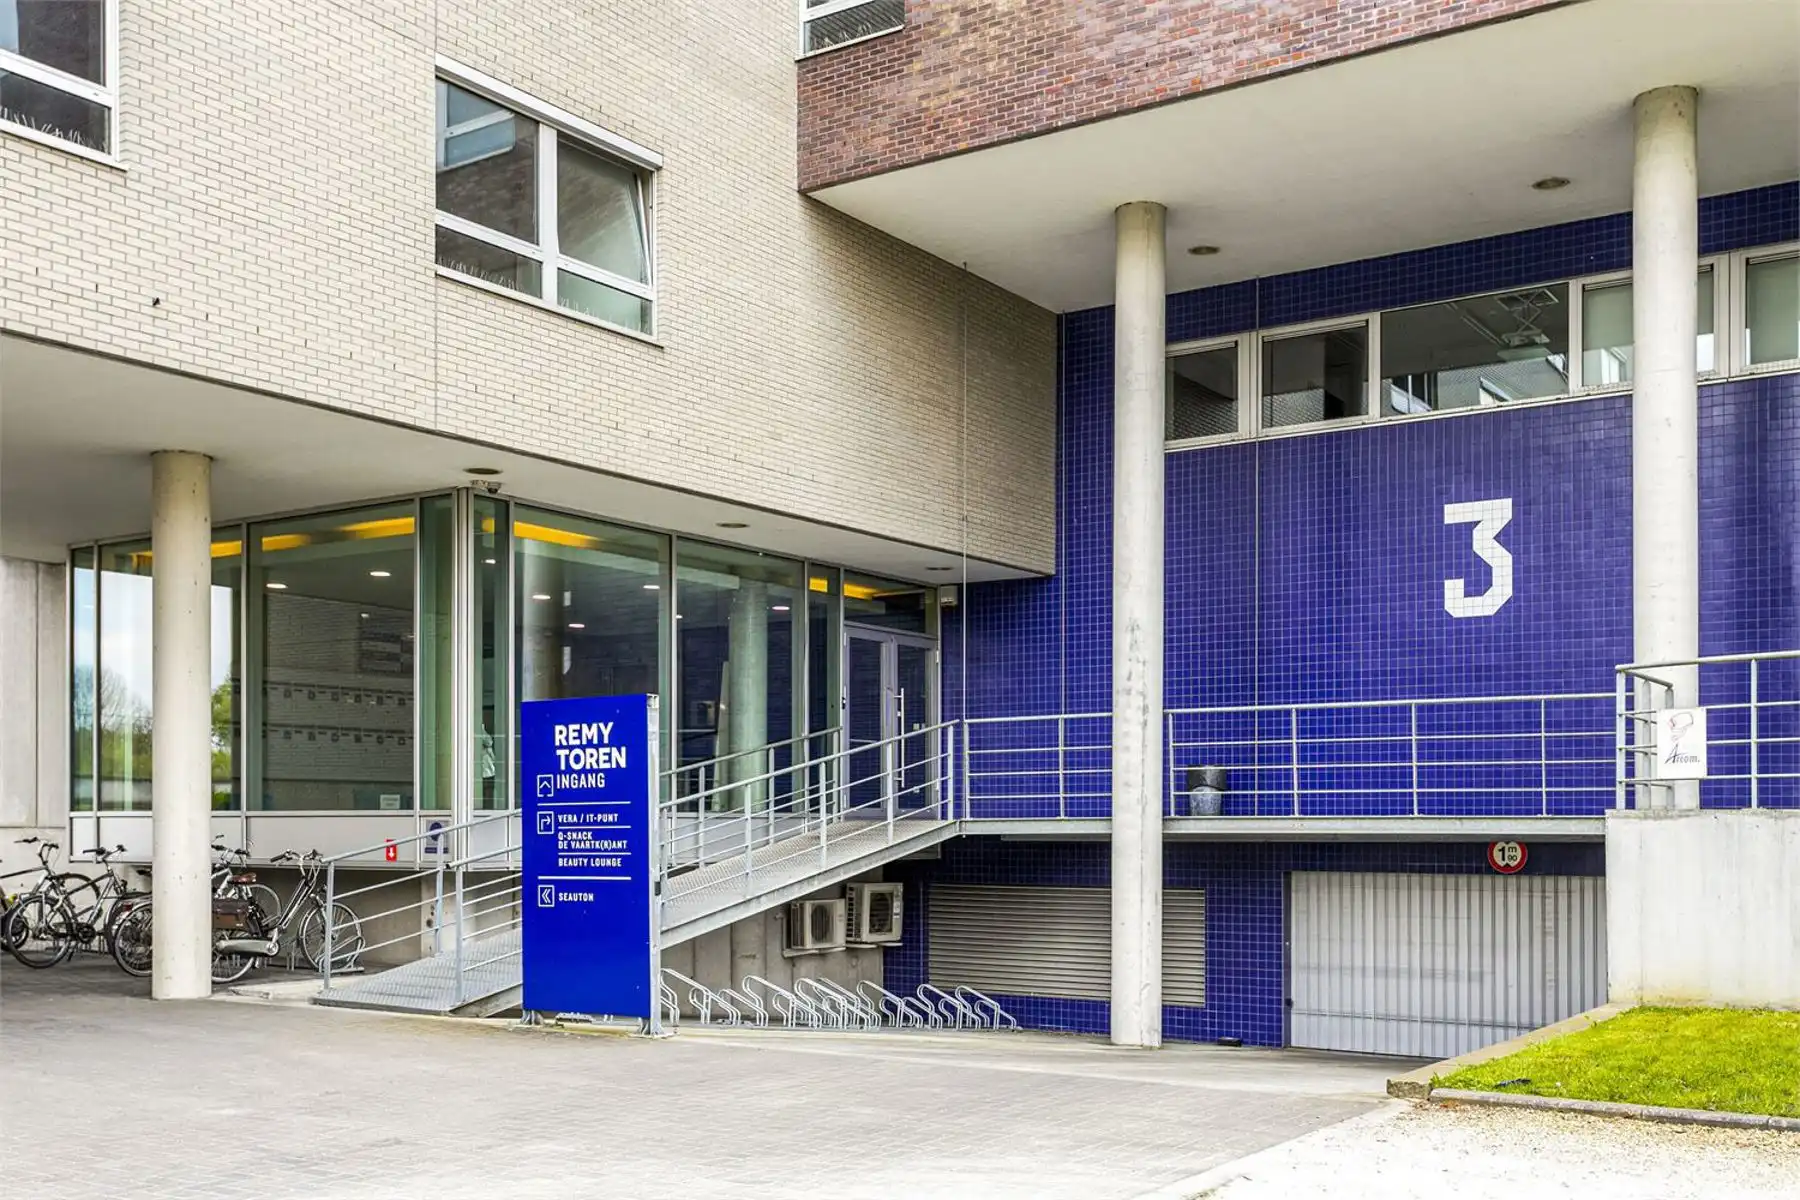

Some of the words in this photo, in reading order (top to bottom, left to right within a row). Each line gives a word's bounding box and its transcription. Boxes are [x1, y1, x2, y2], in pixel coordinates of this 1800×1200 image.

[1444, 498, 1512, 618] 3
[554, 721, 614, 746] REMY
[556, 746, 627, 770] TOREN
[556, 773, 606, 789] INGANG
[558, 814, 578, 823] VERA
[586, 813, 619, 823] IT-PUNT
[558, 831, 593, 840] Q-SNACK
[558, 840, 568, 849] DE
[570, 840, 628, 851] VAARTK(R)ANT
[558, 858, 588, 867] BEAUTY
[590, 858, 622, 867] LOUNGE
[558, 893, 594, 902] SEAUTON
